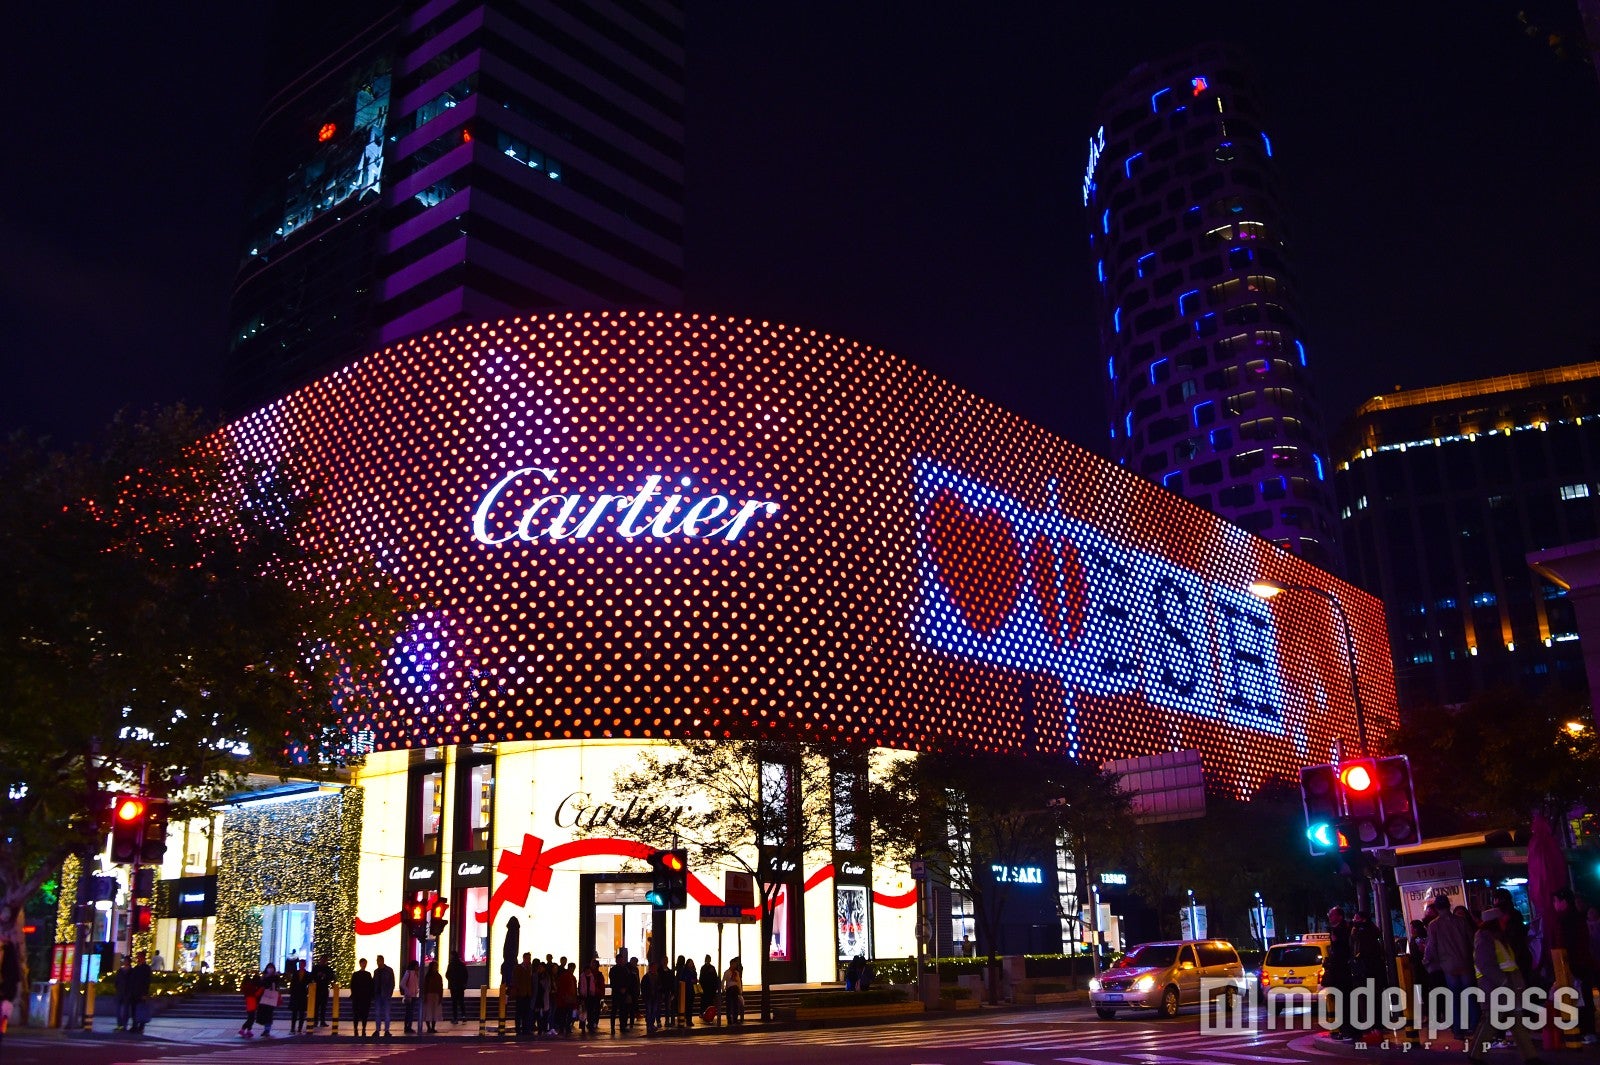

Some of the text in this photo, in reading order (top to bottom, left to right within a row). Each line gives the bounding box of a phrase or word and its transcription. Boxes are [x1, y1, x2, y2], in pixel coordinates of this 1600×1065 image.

[473, 467, 777, 545] Cartier
[555, 791, 693, 829] Cartier
[409, 866, 434, 880] Cartier
[457, 862, 485, 876] Cartier
[841, 861, 865, 875] Cartier
